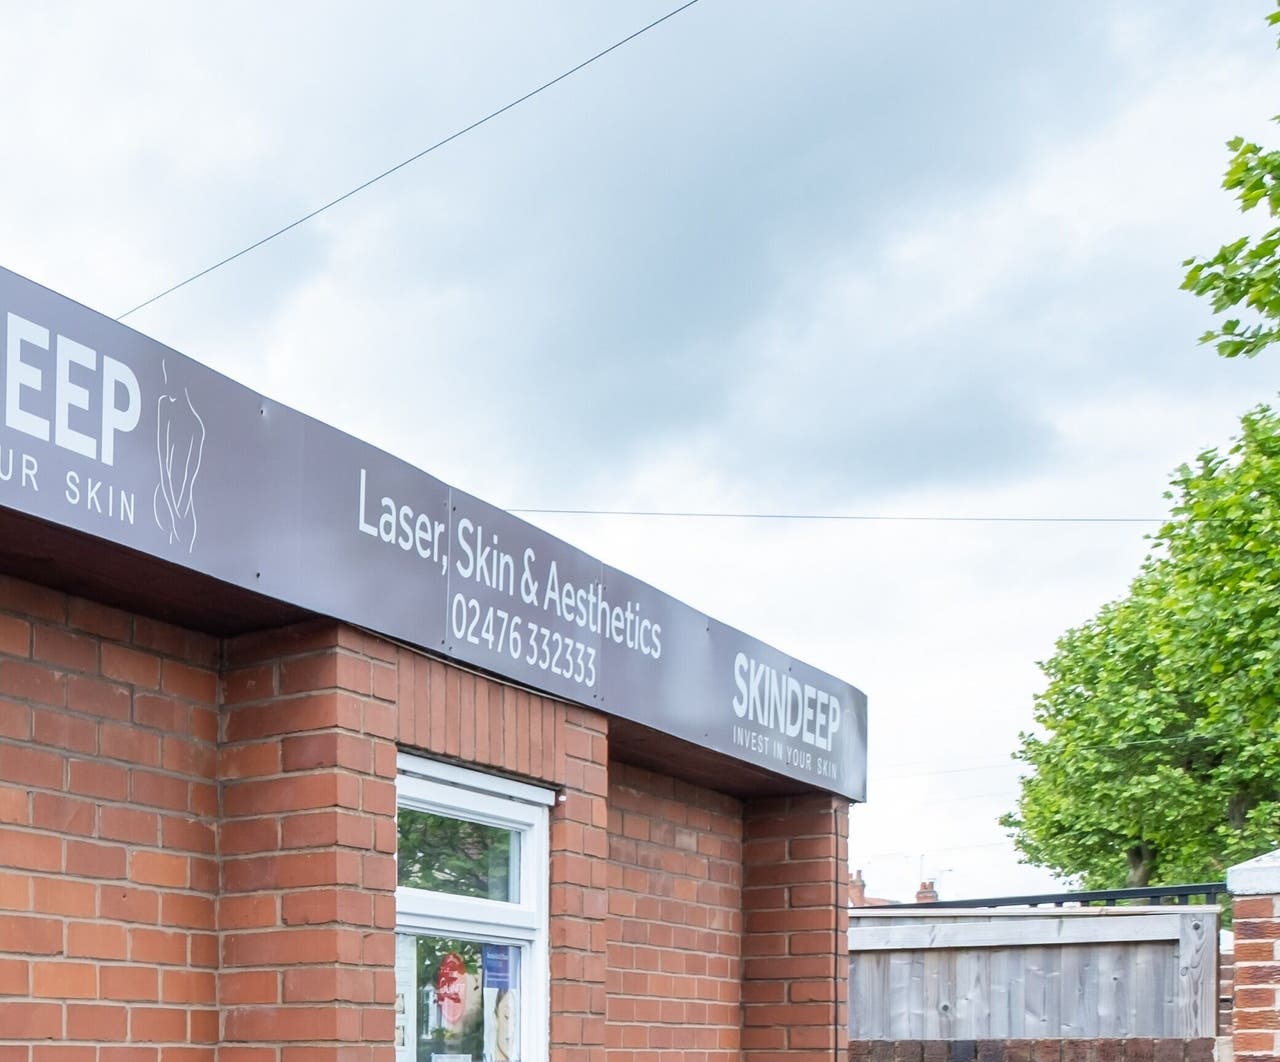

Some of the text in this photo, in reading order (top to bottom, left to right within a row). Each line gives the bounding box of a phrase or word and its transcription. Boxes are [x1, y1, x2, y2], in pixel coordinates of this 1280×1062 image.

[65, 471, 136, 525] SKIN
[358, 468, 662, 660] Laser, Skin & Aesthetics
[452, 593, 597, 688] 02476 332333
[732, 652, 841, 752] SKINDEEP
[733, 725, 838, 782] INVEST IN YOUR SKIN
